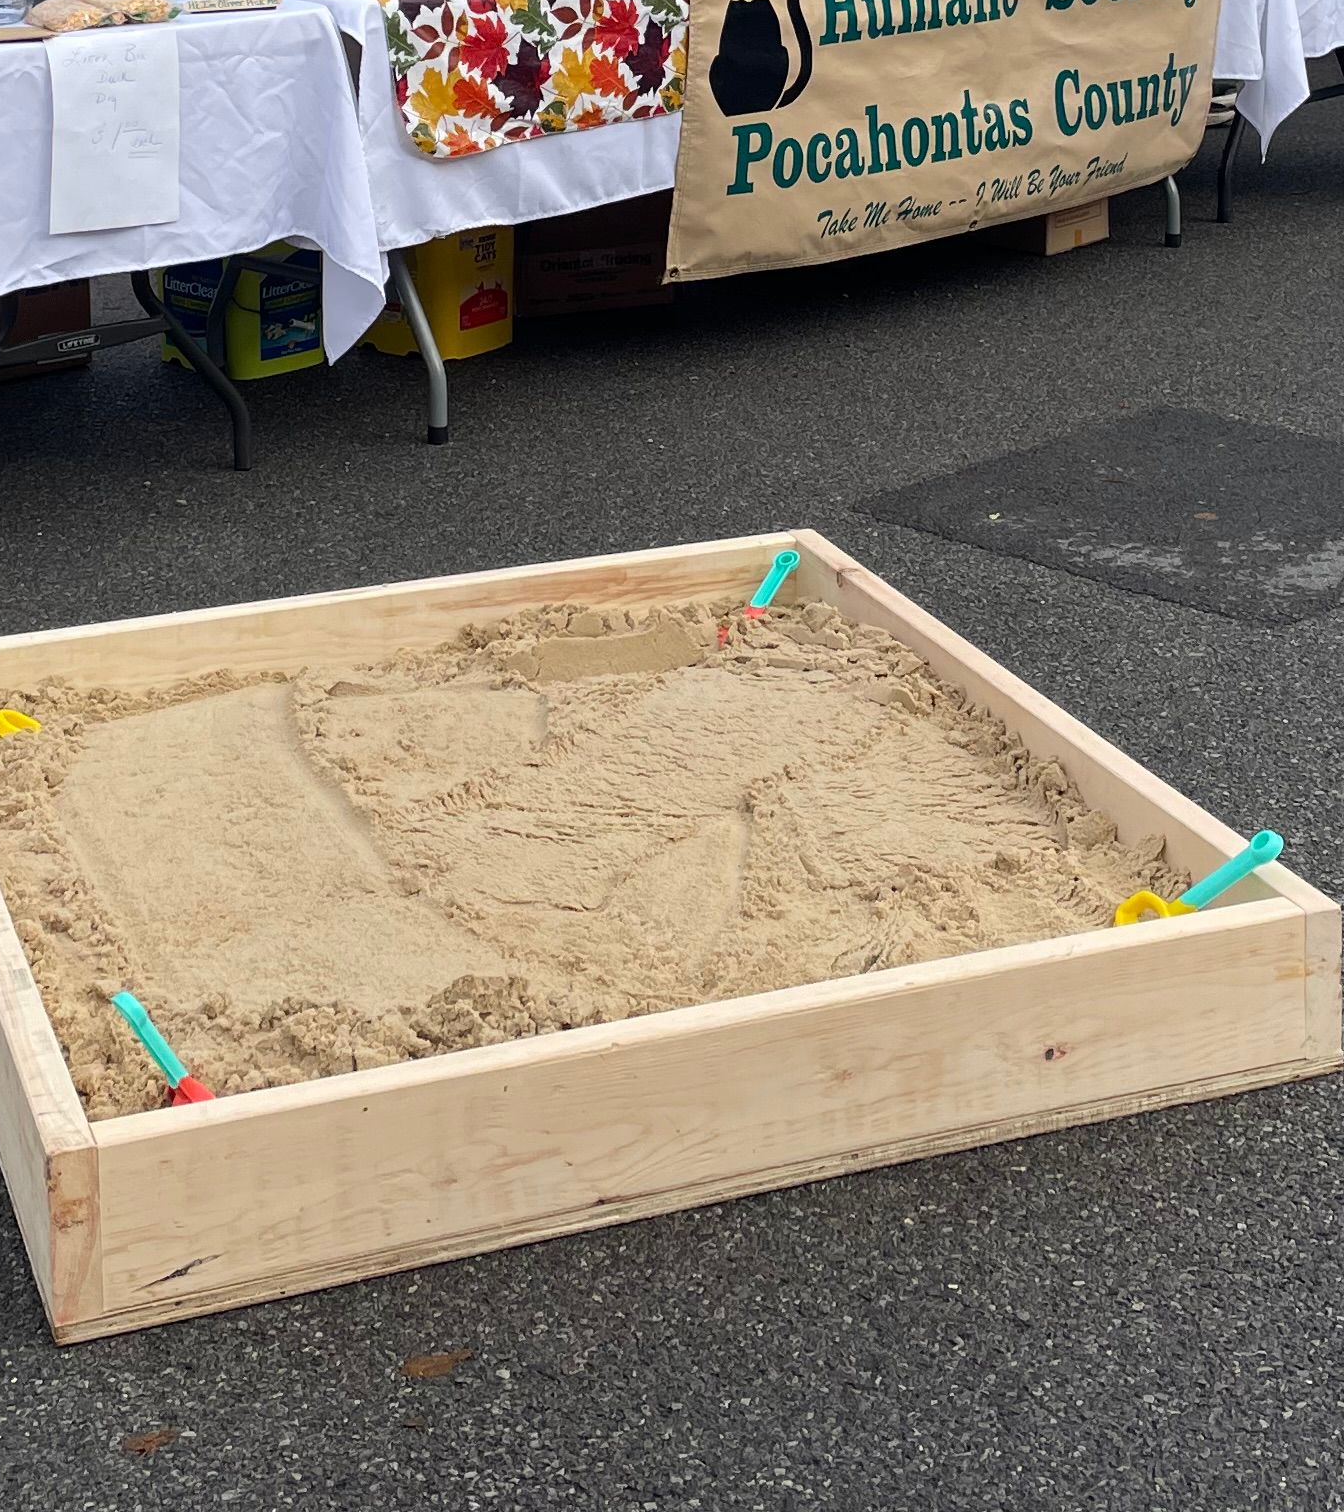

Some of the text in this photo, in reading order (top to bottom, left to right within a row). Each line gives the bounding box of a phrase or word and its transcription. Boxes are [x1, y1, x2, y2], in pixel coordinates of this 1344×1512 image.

[726, 53, 1199, 196] Pocahontas County
[817, 206, 858, 240] Take
[862, 201, 891, 228] Me
[896, 194, 942, 223] Home
[991, 174, 1024, 206] Will
[1026, 169, 1047, 196] Be
[1049, 164, 1083, 197] Your
[1084, 152, 1130, 186] Friend
[474, 241, 497, 254] TIDY
[474, 251, 497, 263] CATS
